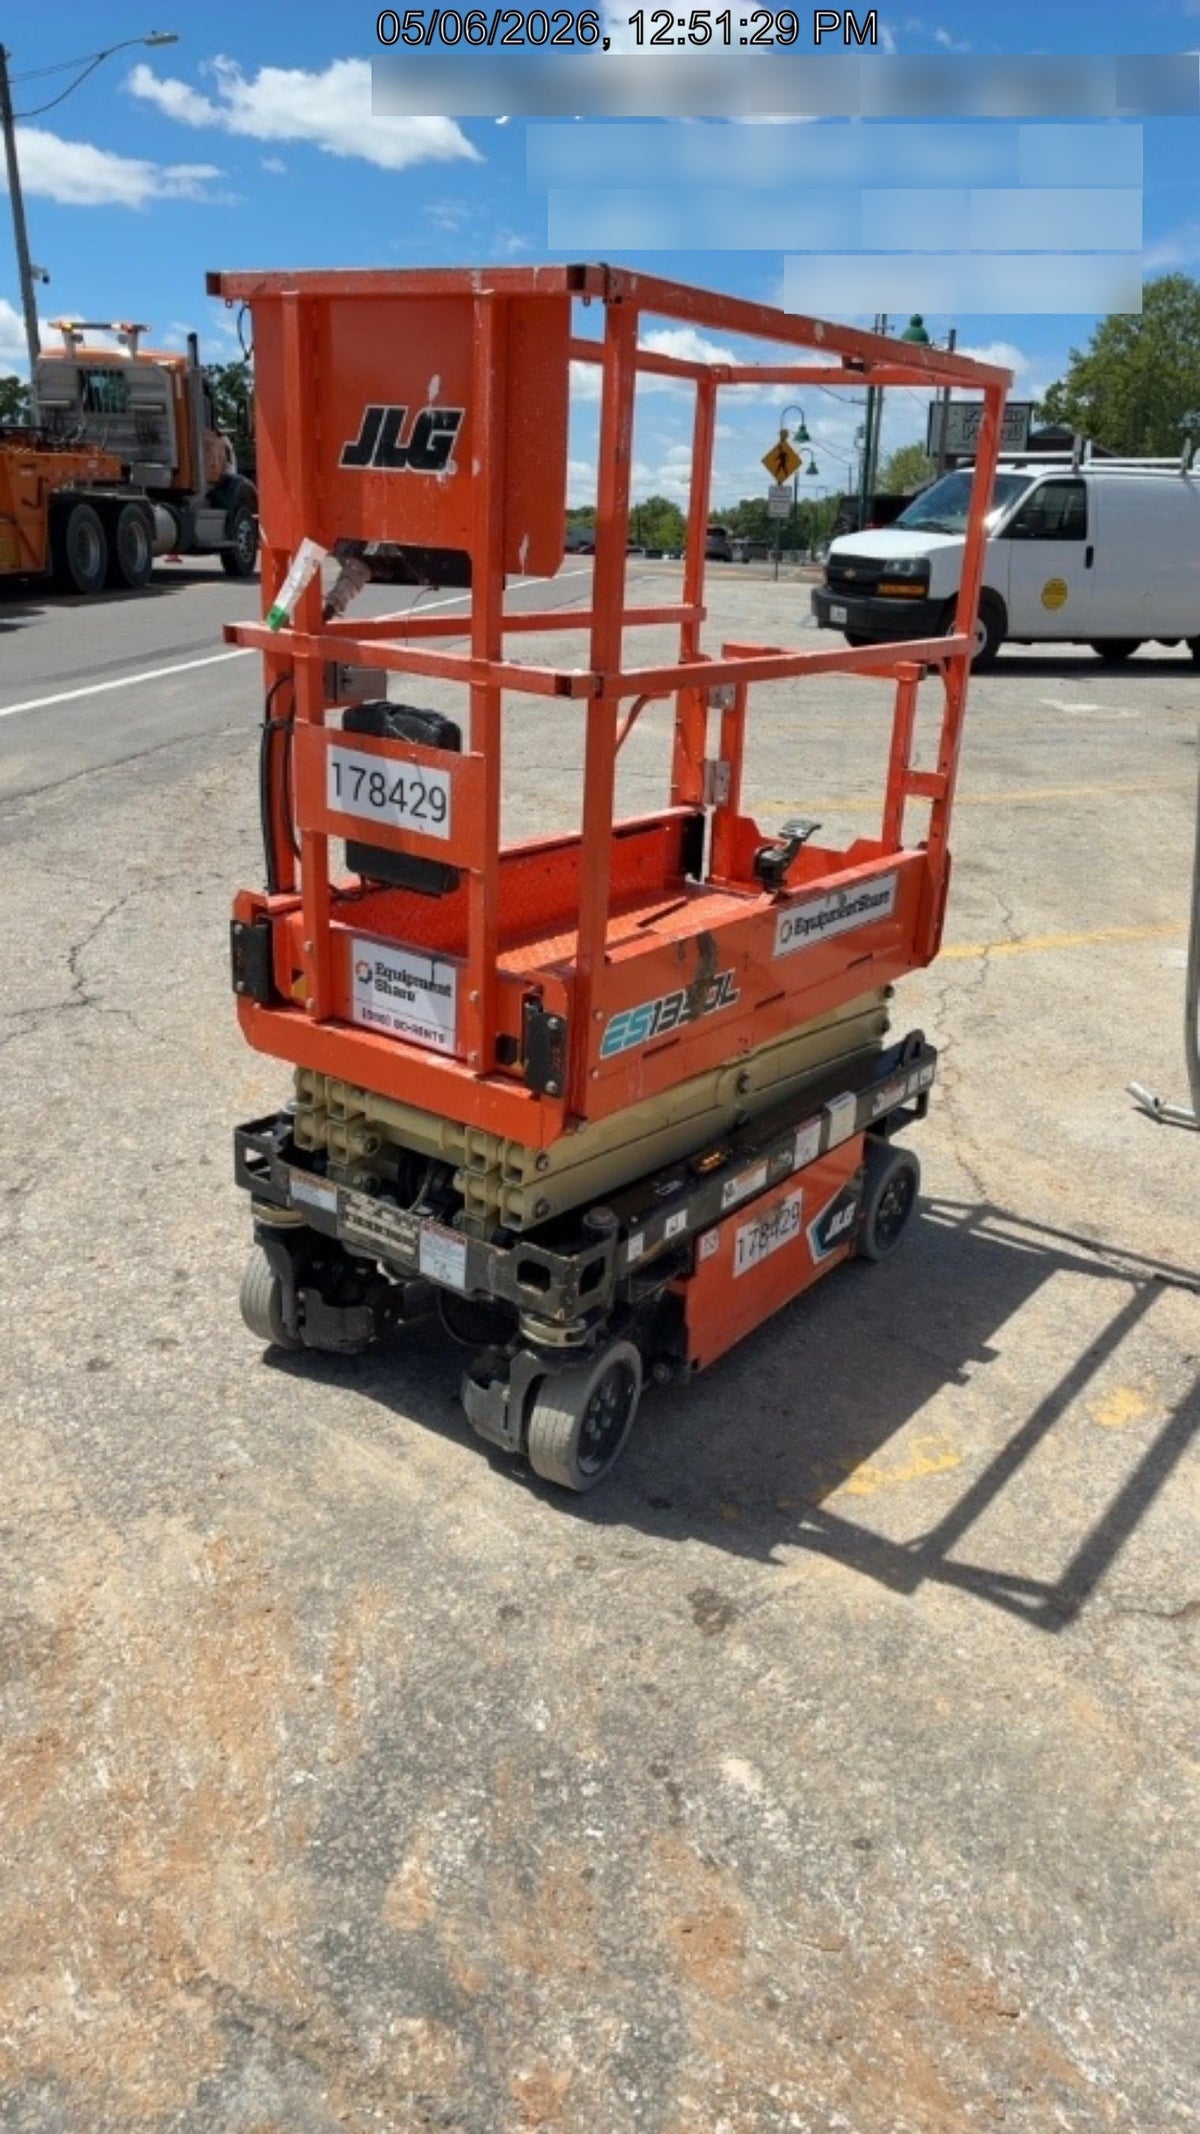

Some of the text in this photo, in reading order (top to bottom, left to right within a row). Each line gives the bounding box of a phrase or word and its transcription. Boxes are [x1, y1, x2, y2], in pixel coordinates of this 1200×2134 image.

[339, 405, 465, 474] JLG
[331, 762, 447, 823] 178429
[736, 1201, 800, 1265] 178429
